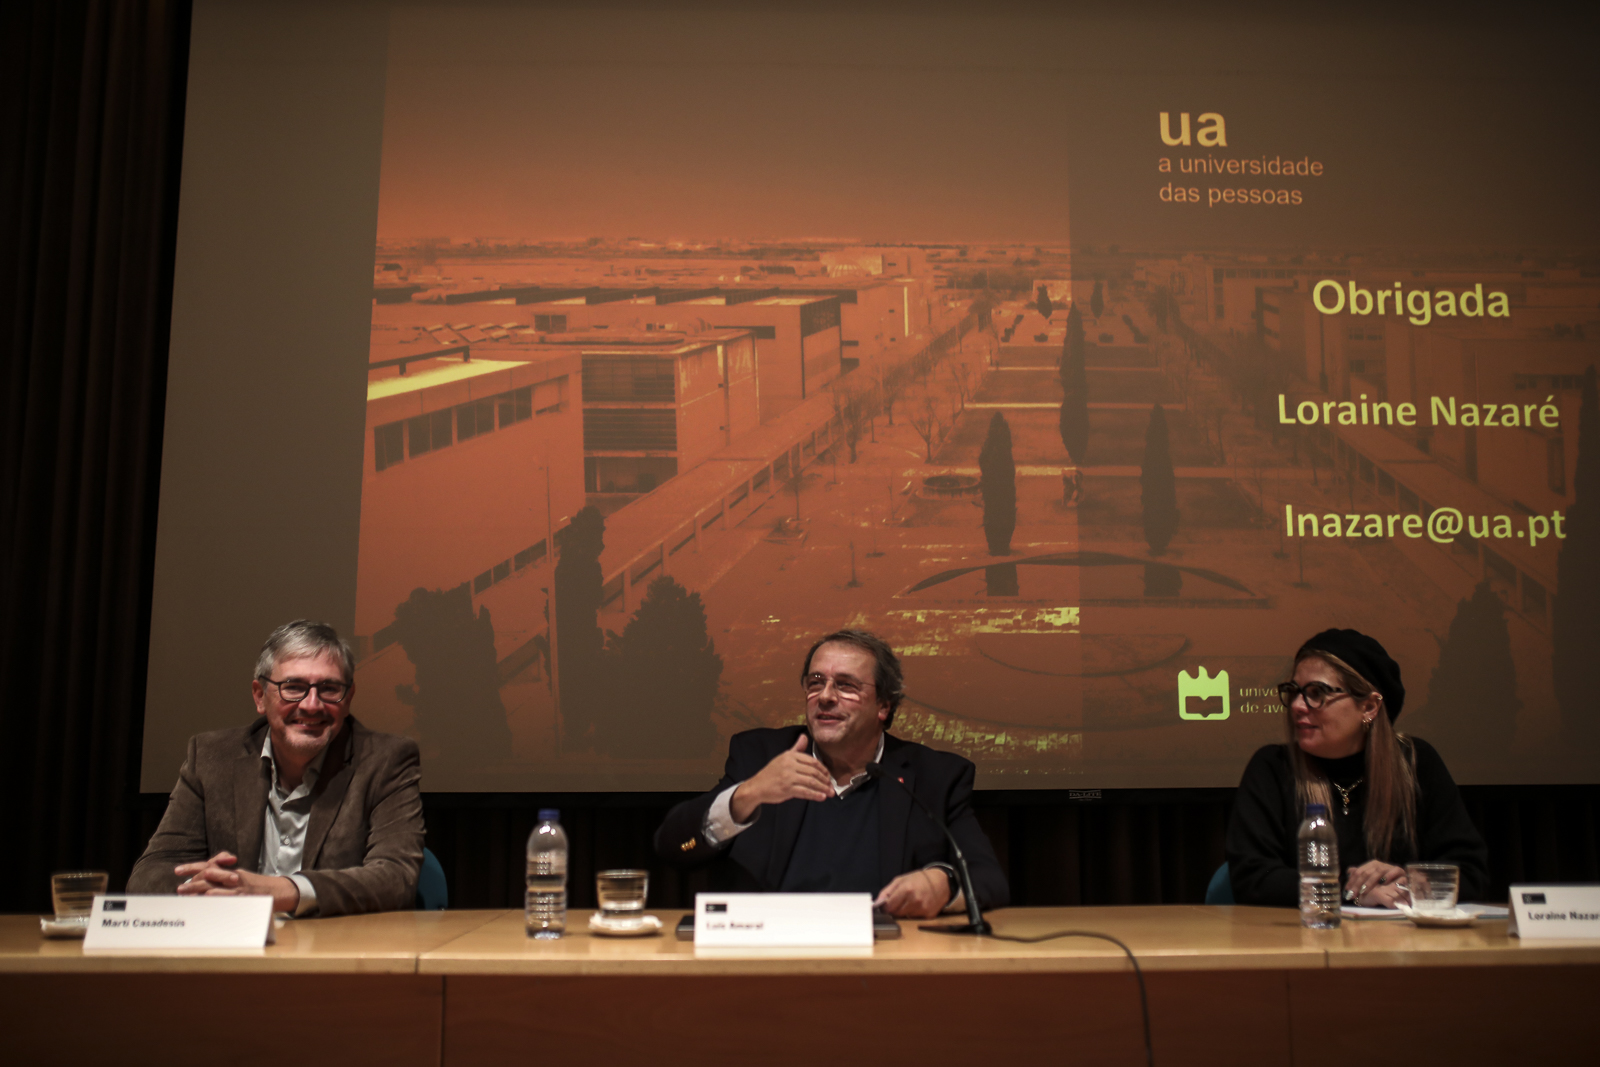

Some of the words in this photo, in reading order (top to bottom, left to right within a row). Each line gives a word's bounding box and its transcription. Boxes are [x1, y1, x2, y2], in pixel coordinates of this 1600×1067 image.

[1159, 112, 1228, 147] ua
[1158, 156, 1172, 174] a
[1180, 154, 1324, 177] universidade
[1159, 182, 1200, 203] das
[1208, 186, 1303, 208] pessoas
[1312, 279, 1511, 326] Obrigada
[1278, 393, 1417, 426] Loraine
[1430, 394, 1560, 428] Nazaré
[1285, 504, 1567, 547] lnazare@ua.pt
[1239, 687, 1279, 697] unive
[1240, 701, 1259, 714] de
[1569, 910, 1600, 921] Nazar
